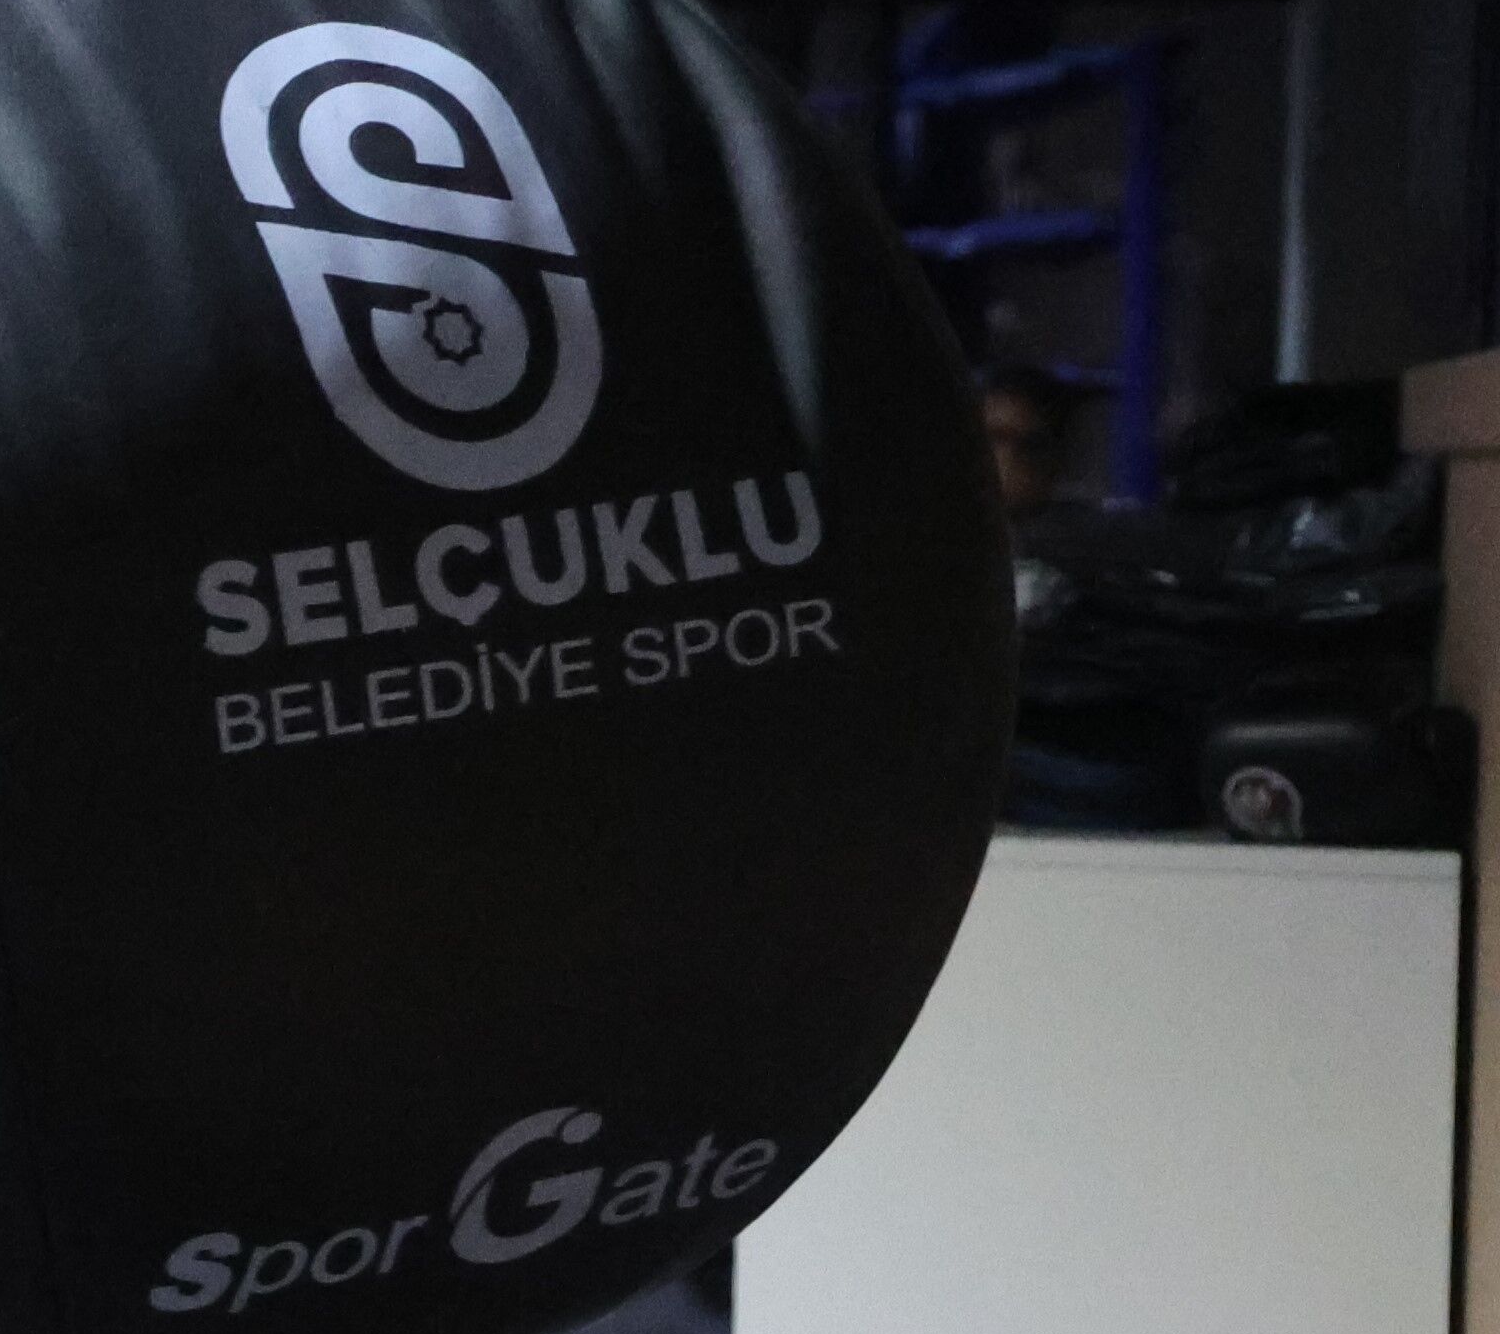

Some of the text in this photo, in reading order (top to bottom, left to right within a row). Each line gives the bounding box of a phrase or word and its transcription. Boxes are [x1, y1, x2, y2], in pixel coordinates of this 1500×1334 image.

[197, 470, 823, 657] SELÇUKLU
[215, 598, 841, 754] BELEDİYE SPOR
